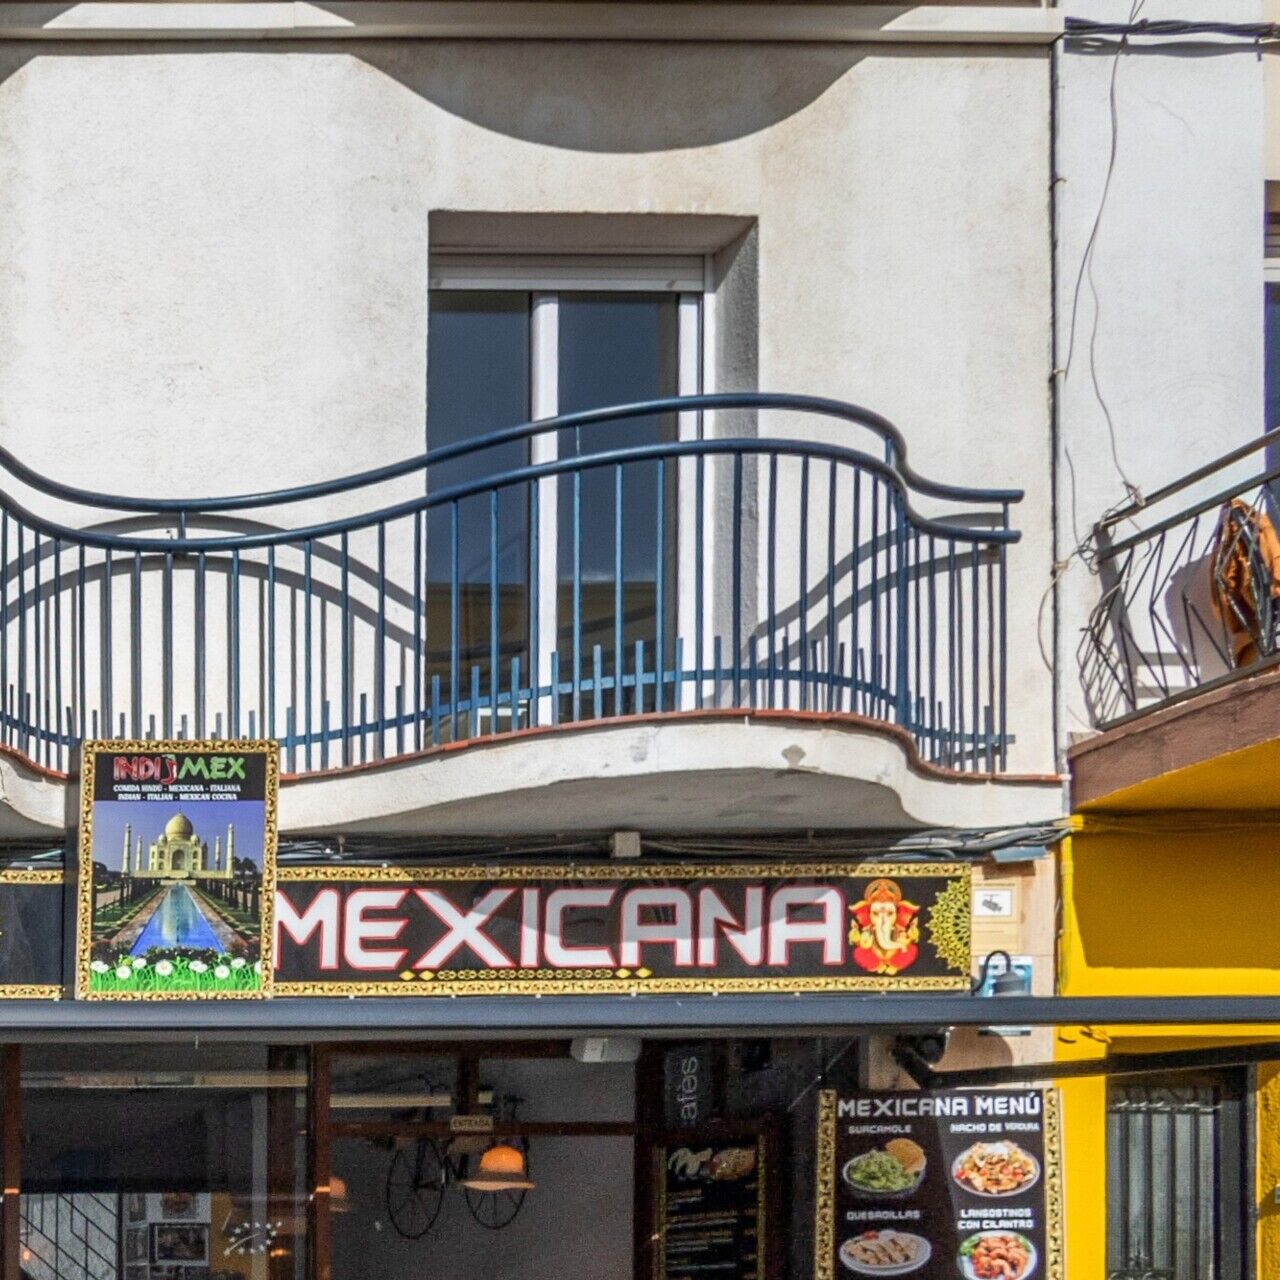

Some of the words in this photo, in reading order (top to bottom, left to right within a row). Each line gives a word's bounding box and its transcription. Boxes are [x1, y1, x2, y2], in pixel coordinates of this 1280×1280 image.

[113, 756, 161, 781] INDI
[178, 756, 246, 780] MEX
[113, 784, 140, 792] COMIDA
[168, 784, 204, 792] MEXICANA
[209, 784, 241, 792] ITALIANA
[274, 886, 845, 970] MEXICANA
[838, 1097, 969, 1118] MEXICANA
[975, 1091, 1041, 1116] MENÚ
[848, 1124, 912, 1134] GUACAMOLE
[987, 1122, 1002, 1132] DE
[846, 1210, 920, 1220] QUESADILLAS
[960, 1208, 1033, 1218] LANGOSTINOS
[958, 1220, 981, 1229] CON
[981, 1220, 1034, 1229] CILANTRO
